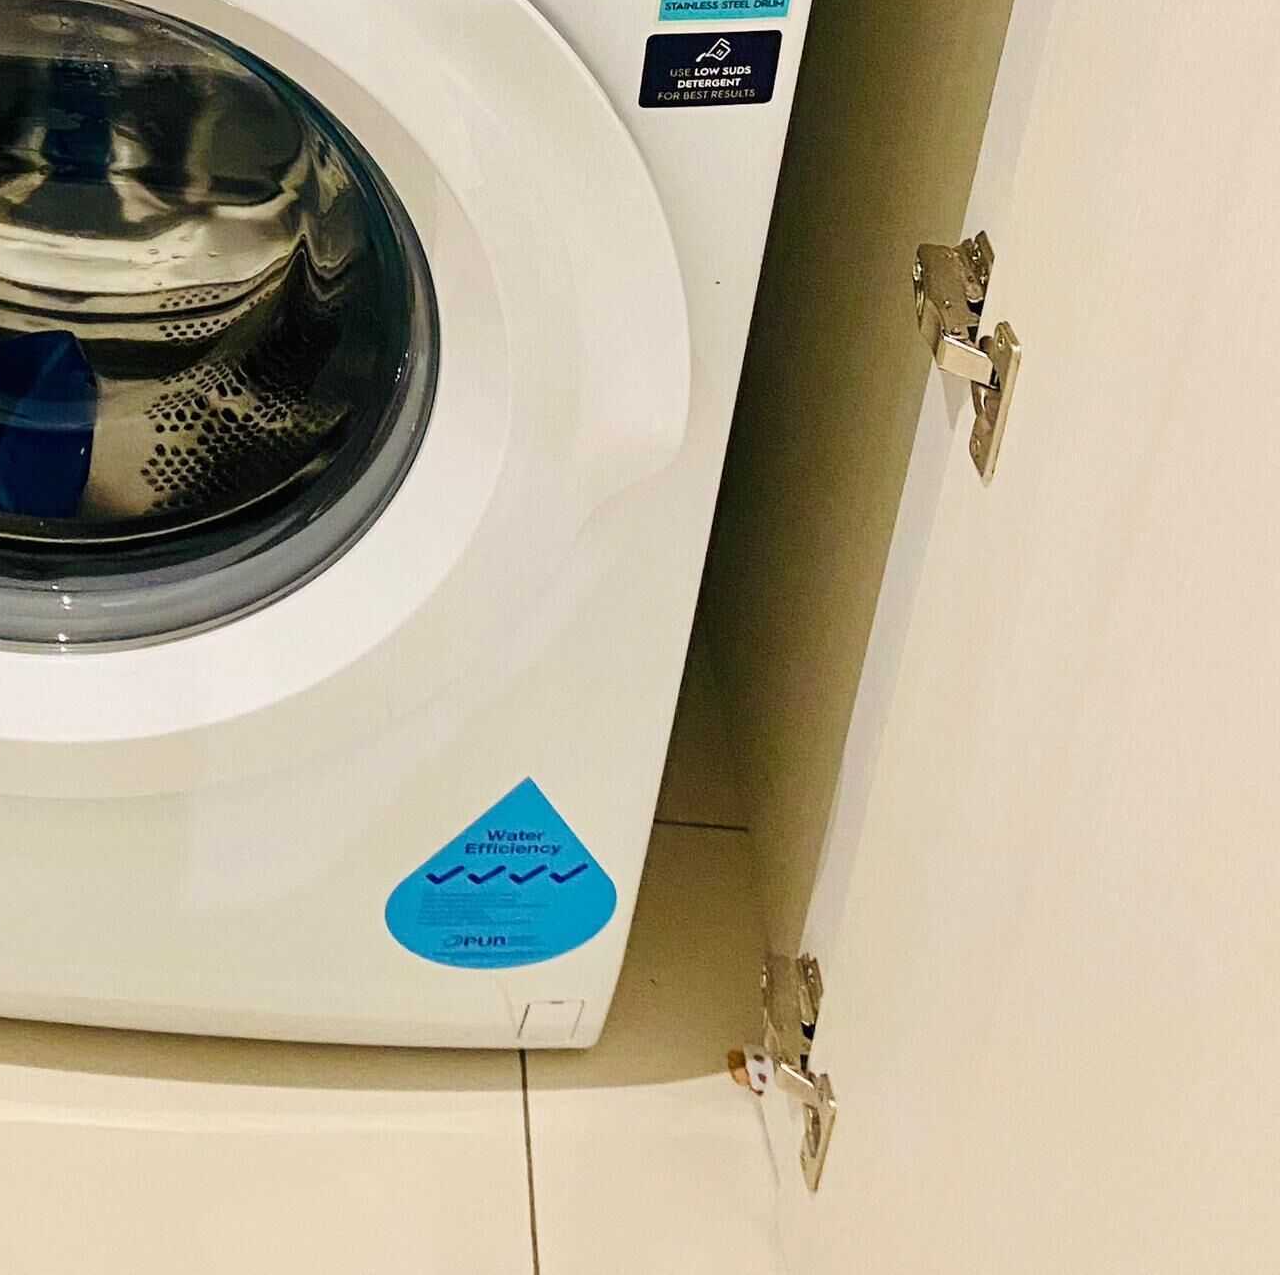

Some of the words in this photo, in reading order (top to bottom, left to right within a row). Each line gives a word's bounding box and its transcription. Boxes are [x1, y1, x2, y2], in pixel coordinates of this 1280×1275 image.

[665, 1, 719, 11] STAINLESS
[721, 0, 751, 10] STEEL
[753, 0, 785, 9] DRUM
[670, 68, 692, 78] USE
[694, 66, 720, 77] LOW
[722, 65, 752, 76] SUDS
[677, 77, 742, 89] DETERGENT
[657, 91, 680, 101] FOR
[683, 90, 708, 100] BEST
[711, 88, 756, 99] RESULTS
[487, 829, 545, 842] Water
[464, 842, 562, 856] Efficiency
